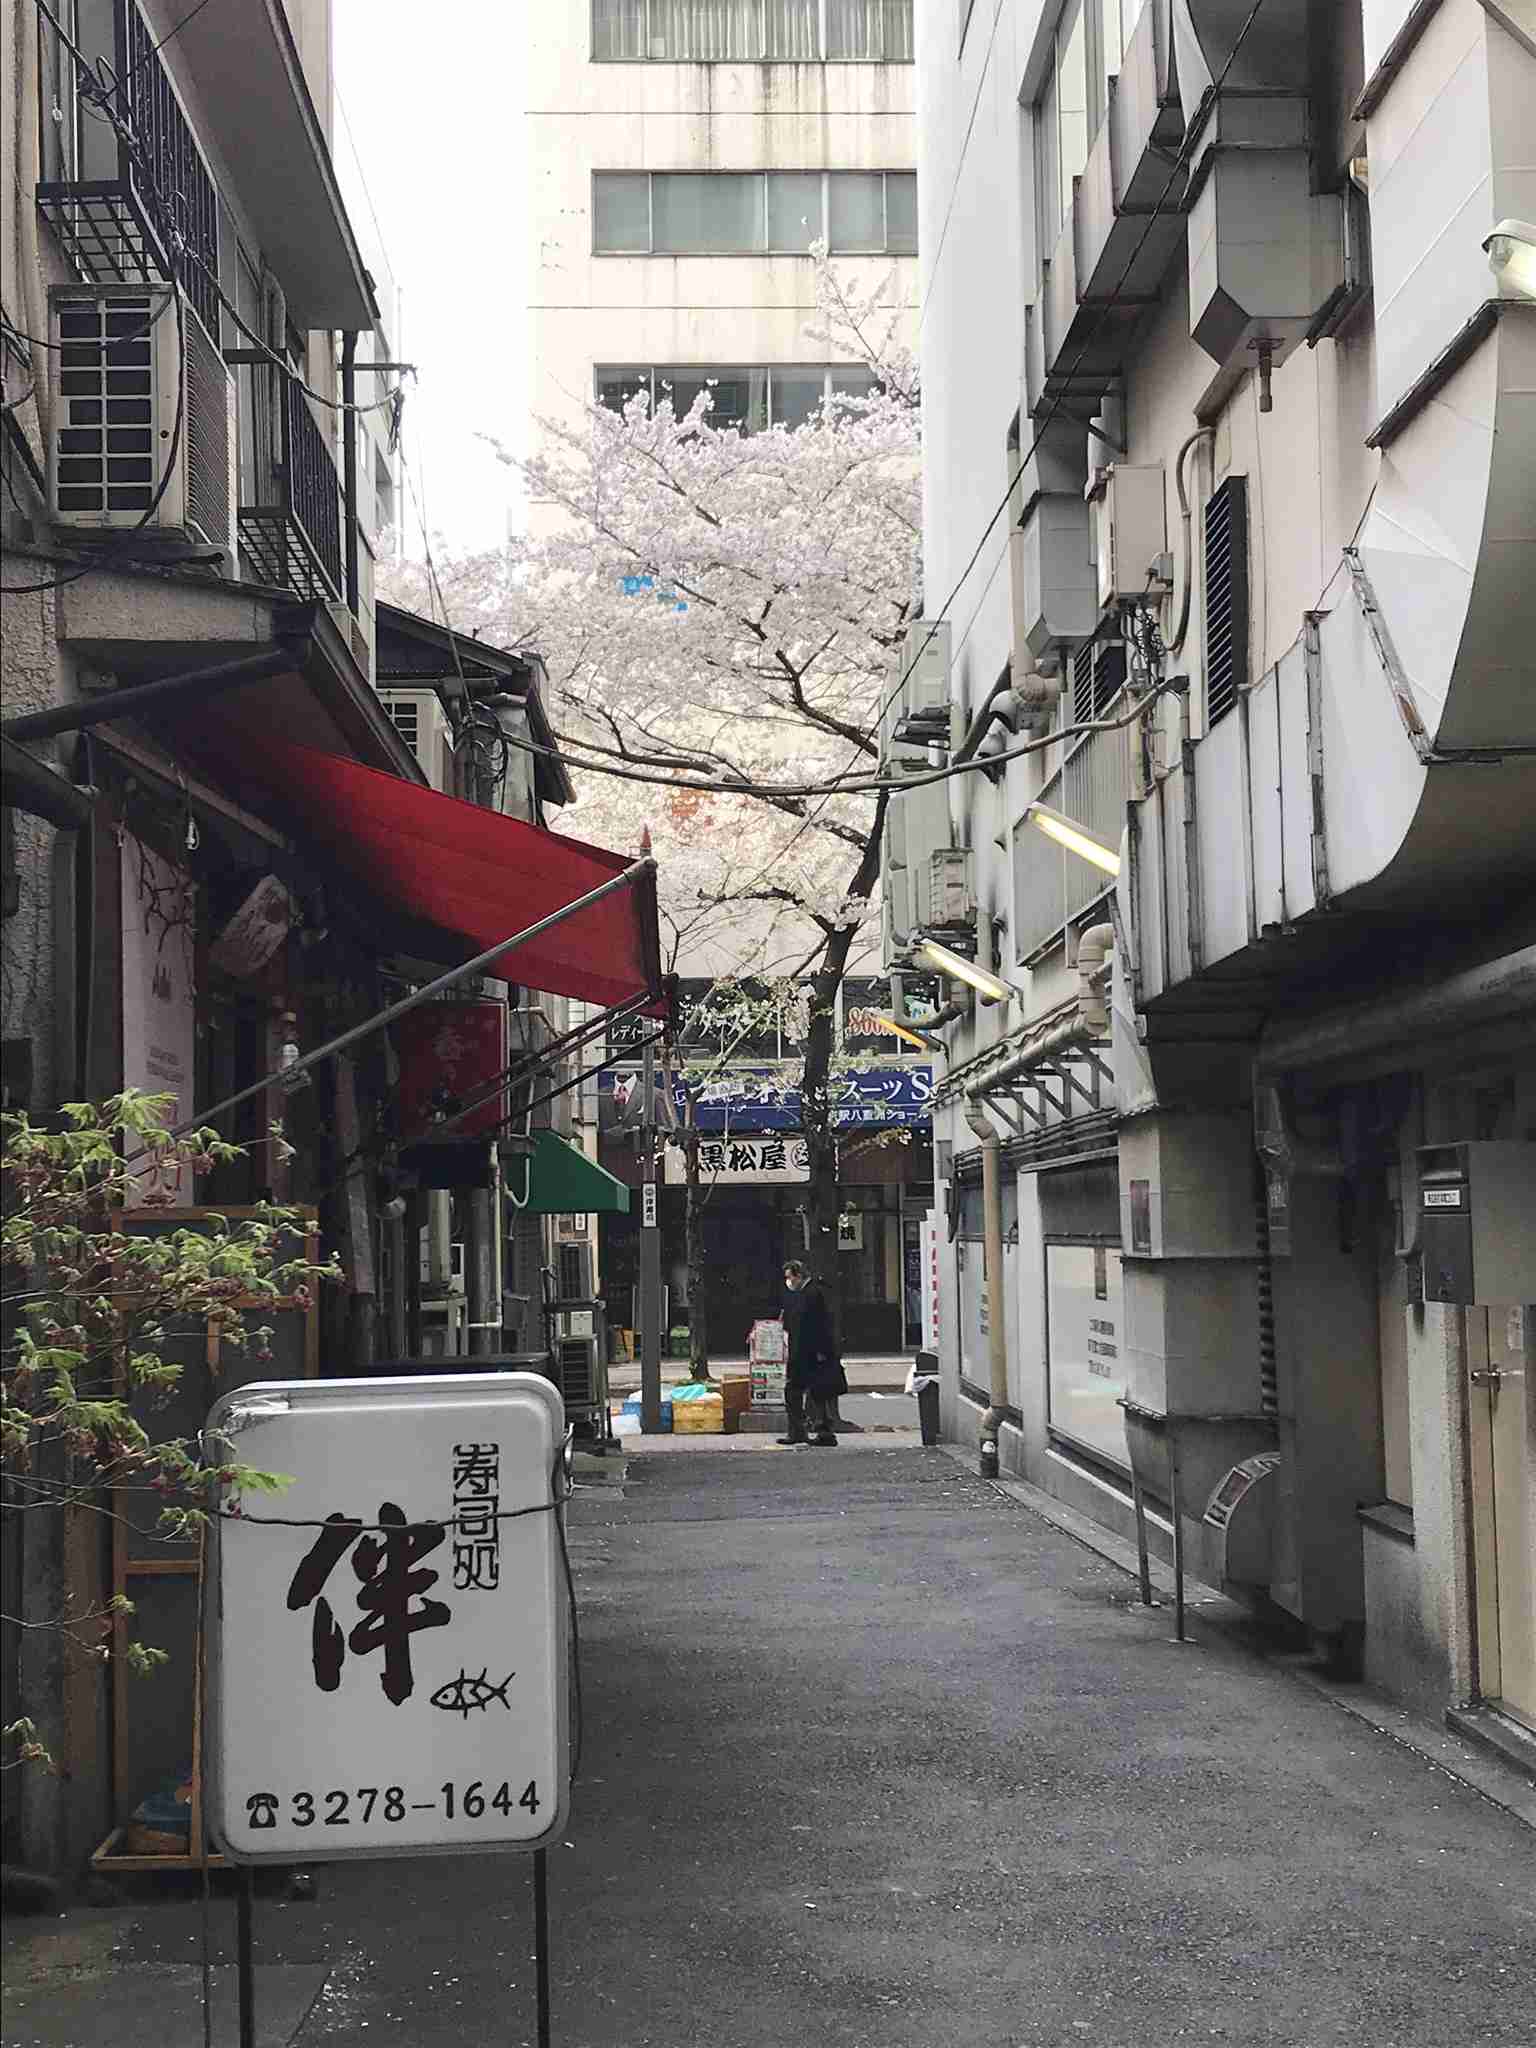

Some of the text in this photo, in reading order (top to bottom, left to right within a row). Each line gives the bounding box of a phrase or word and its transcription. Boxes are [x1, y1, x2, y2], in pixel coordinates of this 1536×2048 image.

[840, 1079, 903, 1101] スーツ
[699, 1138, 787, 1172] 黒松屋
[291, 1781, 541, 1828] 3278-1644
